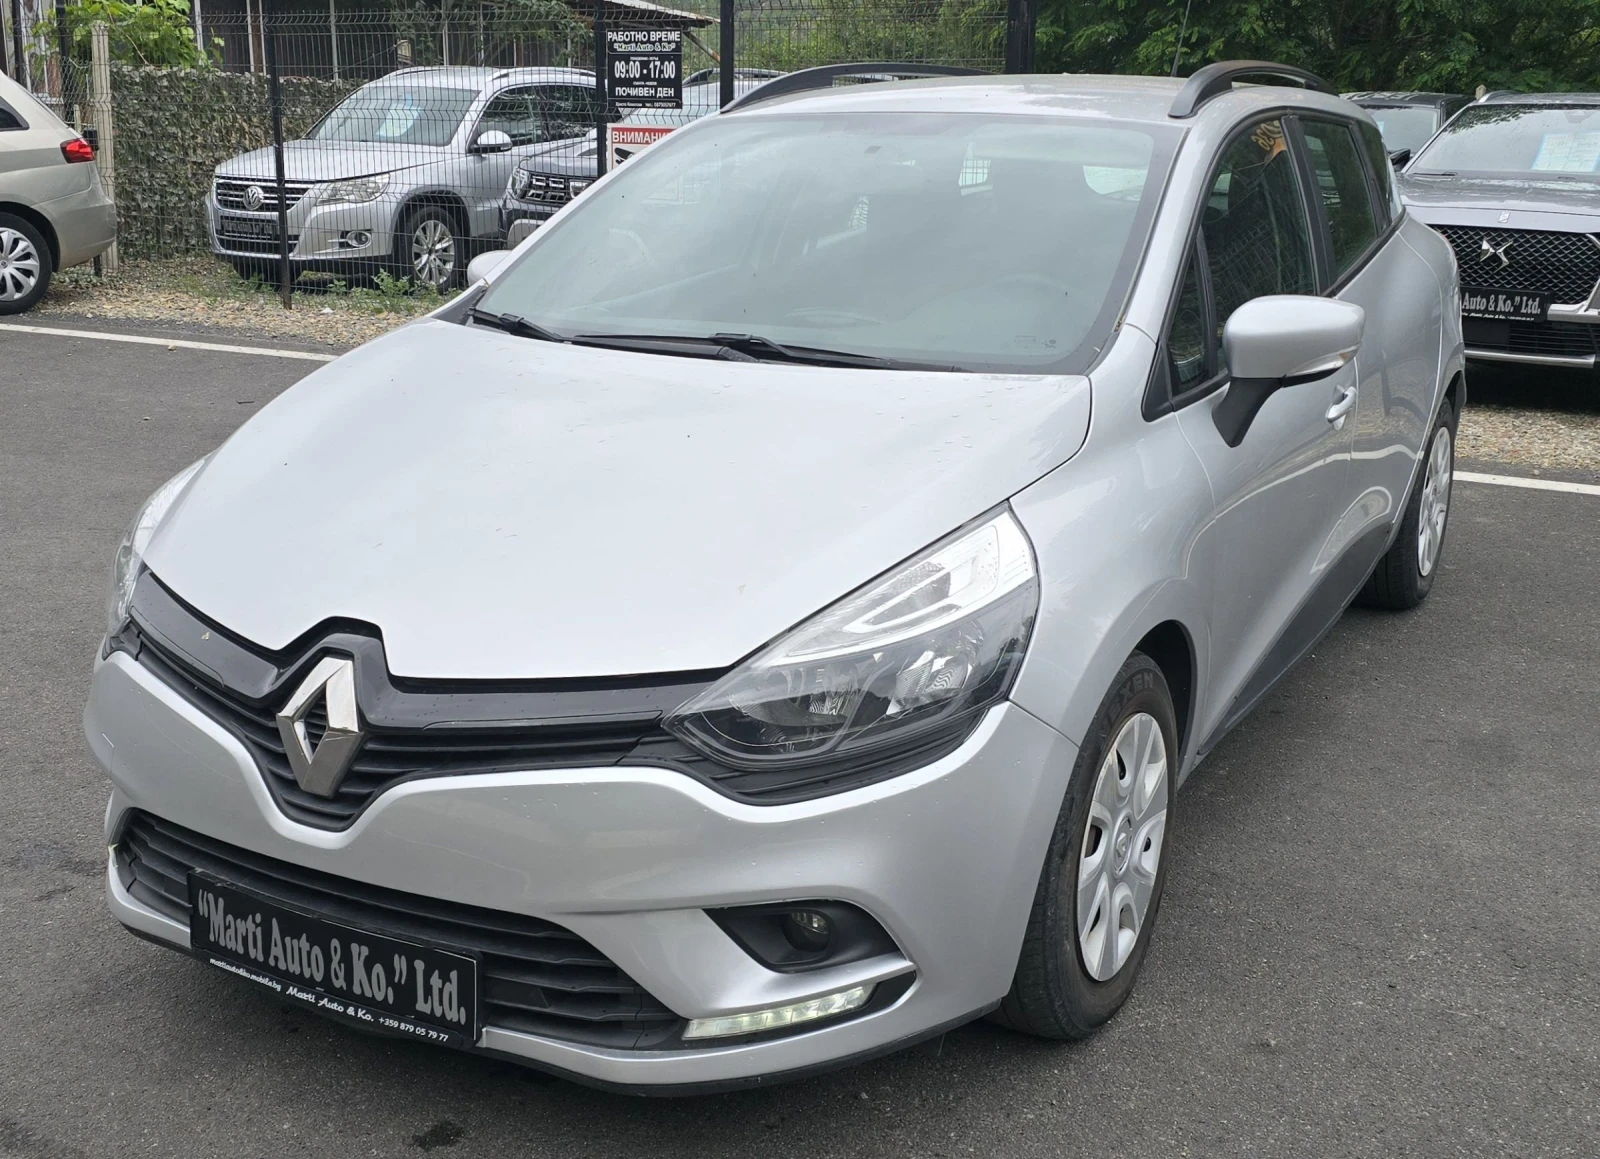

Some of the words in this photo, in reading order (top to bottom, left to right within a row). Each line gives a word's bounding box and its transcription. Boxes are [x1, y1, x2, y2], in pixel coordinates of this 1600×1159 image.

[607, 31, 648, 42] РАБОТНО
[650, 31, 681, 42] ВРЕМЕ
[636, 42, 654, 51] Auto
[654, 42, 661, 51] &
[614, 60, 640, 79] 09:00
[648, 60, 676, 79] 17:00
[615, 87, 655, 97] ПОЧИВЕН
[656, 87, 675, 99] ДЕН
[612, 131, 668, 143] ВНИМАН
[1461, 292, 1487, 311] Auto
[1487, 294, 1495, 312] &
[1520, 296, 1541, 314] Ltd.
[268, 917, 325, 982] Auto
[330, 938, 347, 991] &
[414, 959, 467, 1026] Ltd.
[286, 986, 316, 1003] Marti
[317, 997, 345, 1013] Auto
[346, 1006, 355, 1017] &
[357, 1008, 375, 1022] Ko.
[378, 1016, 399, 1028] +359
[399, 1022, 414, 1033] 879
[415, 1027, 426, 1037] 05
[427, 1030, 438, 1039] 79
[438, 1033, 449, 1042] 77
